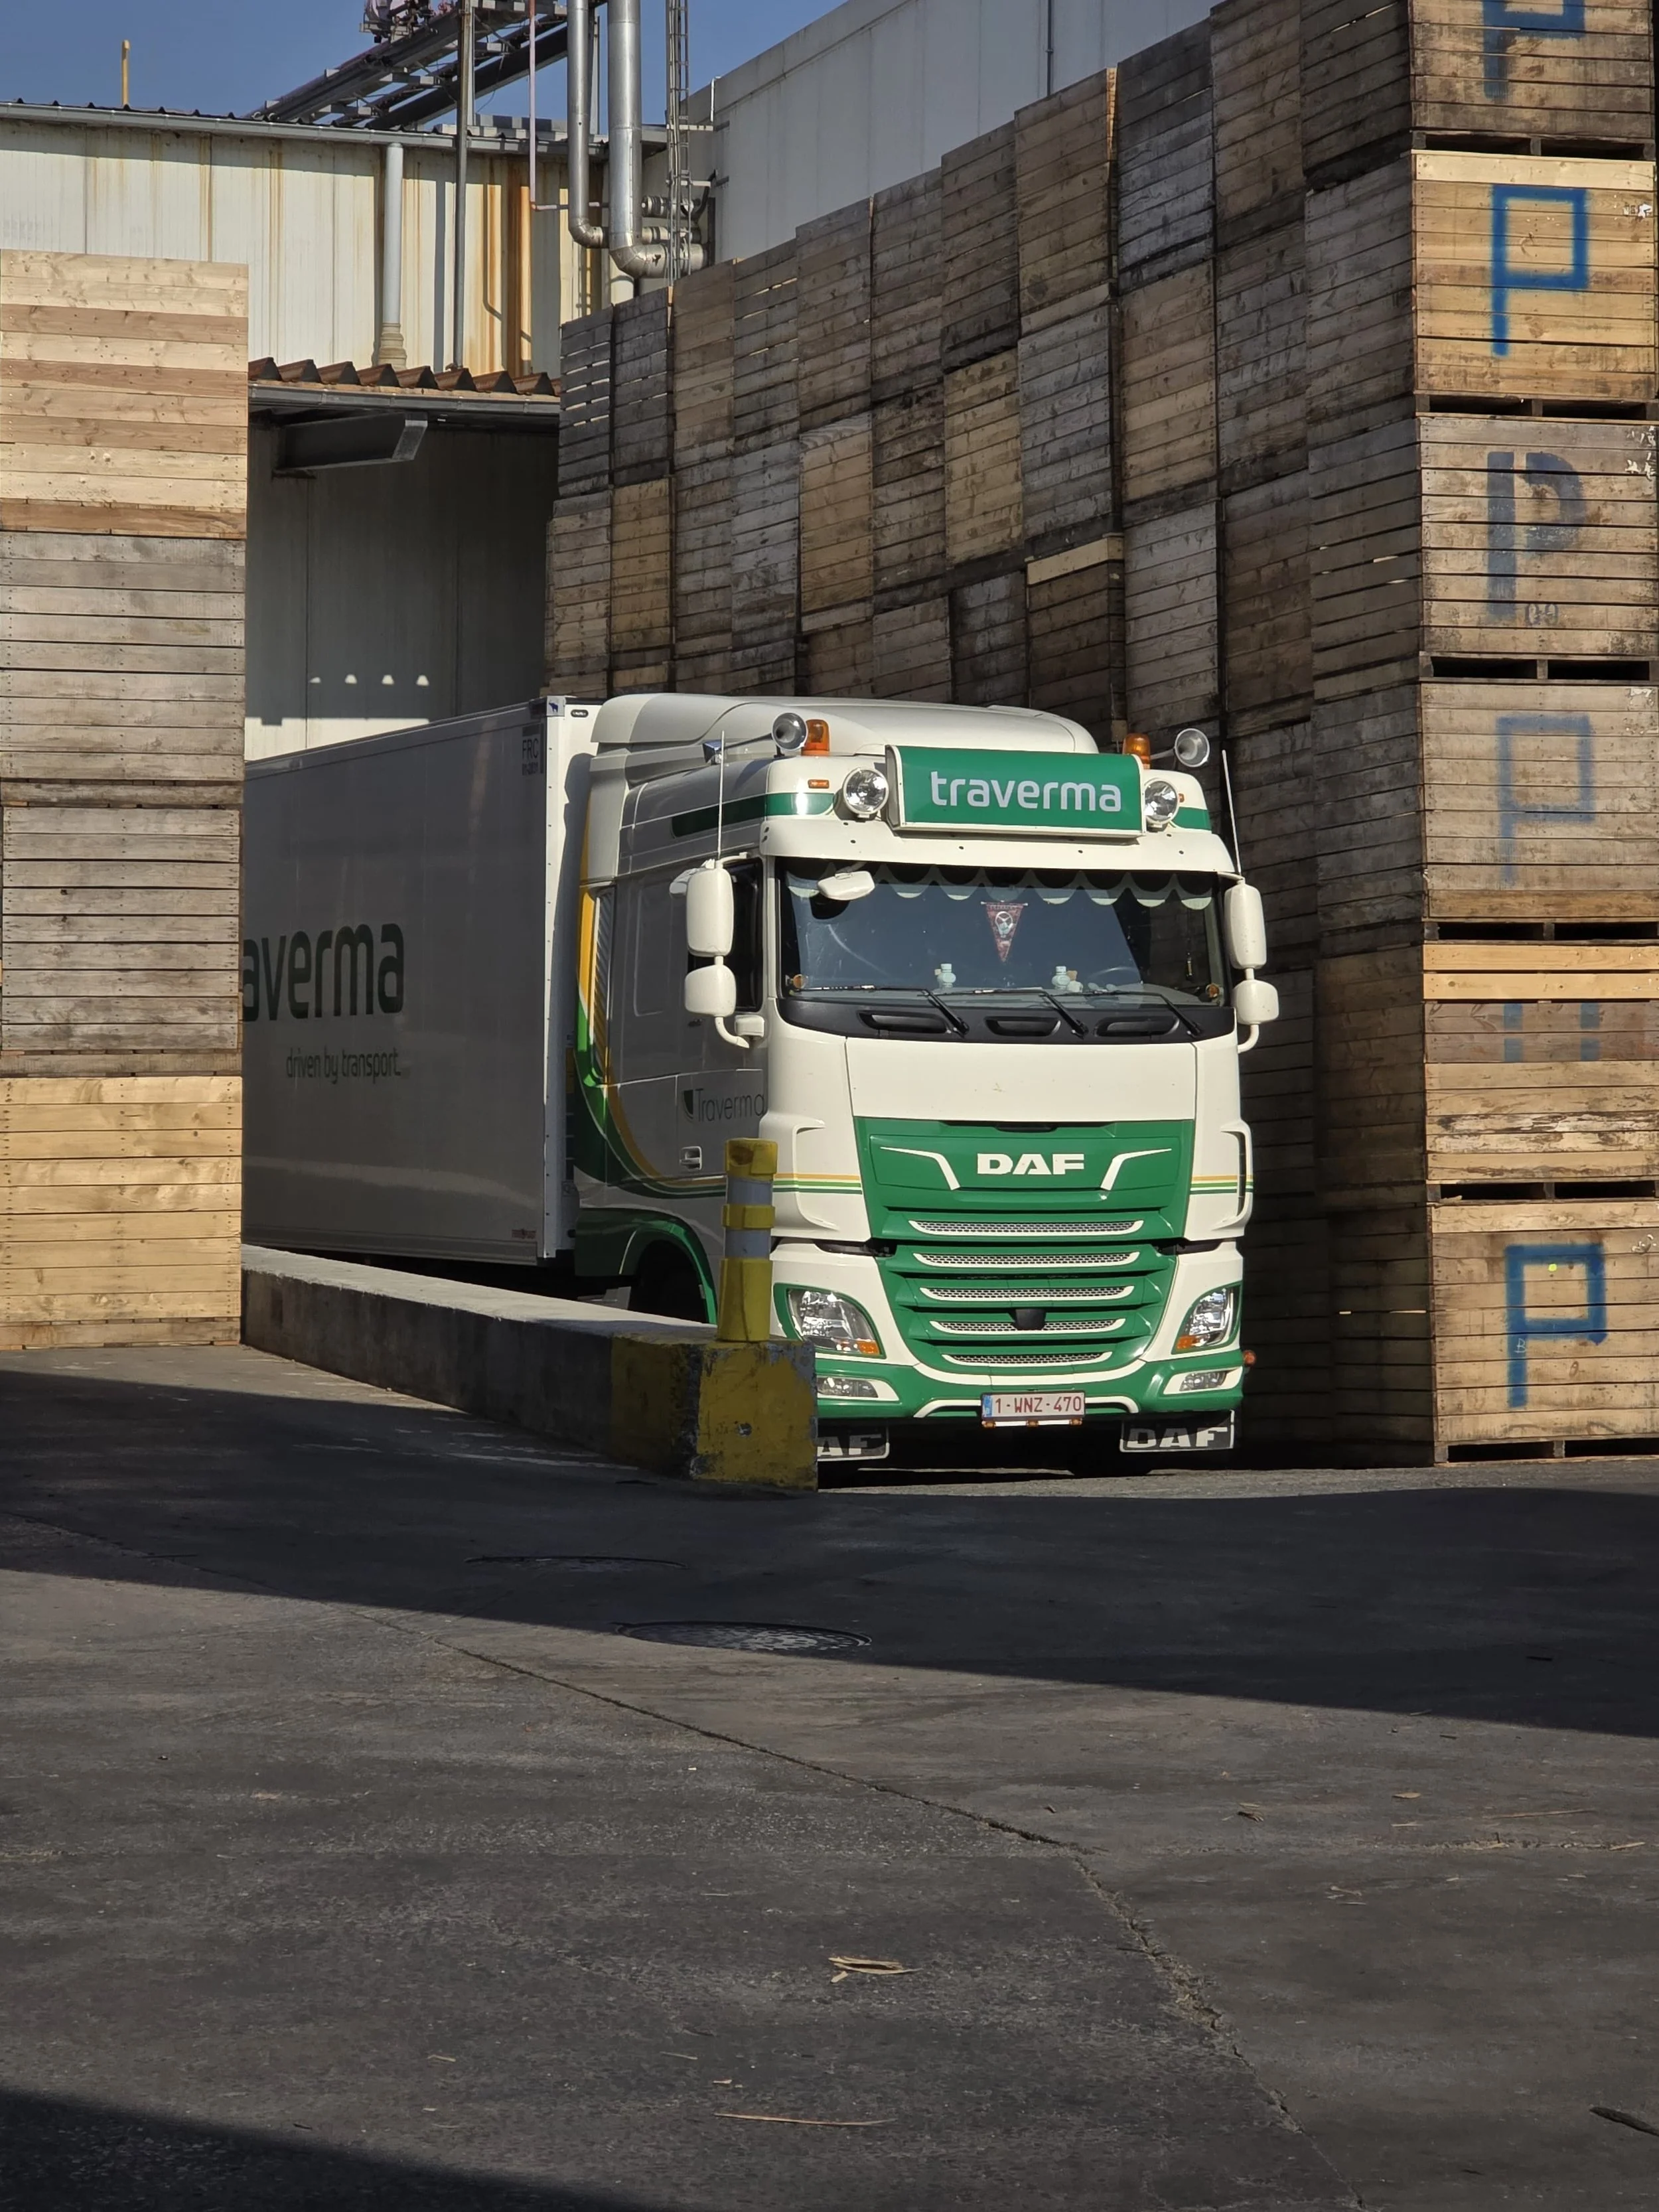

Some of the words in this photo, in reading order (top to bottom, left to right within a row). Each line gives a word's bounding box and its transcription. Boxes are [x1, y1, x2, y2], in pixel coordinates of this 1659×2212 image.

[1490, 184, 1589, 356] P
[1487, 451, 1585, 619] P
[522, 737, 539, 761] FRC
[930, 771, 1122, 812] traverma
[1496, 715, 1594, 887] P
[243, 922, 404, 1022] averma
[286, 1047, 321, 1078] driven
[324, 1044, 339, 1084] by
[695, 1088, 766, 1122] Traverma
[977, 1153, 1084, 1175] DAF
[1504, 1243, 1607, 1408] P
[1126, 1426, 1228, 1448] DAF
